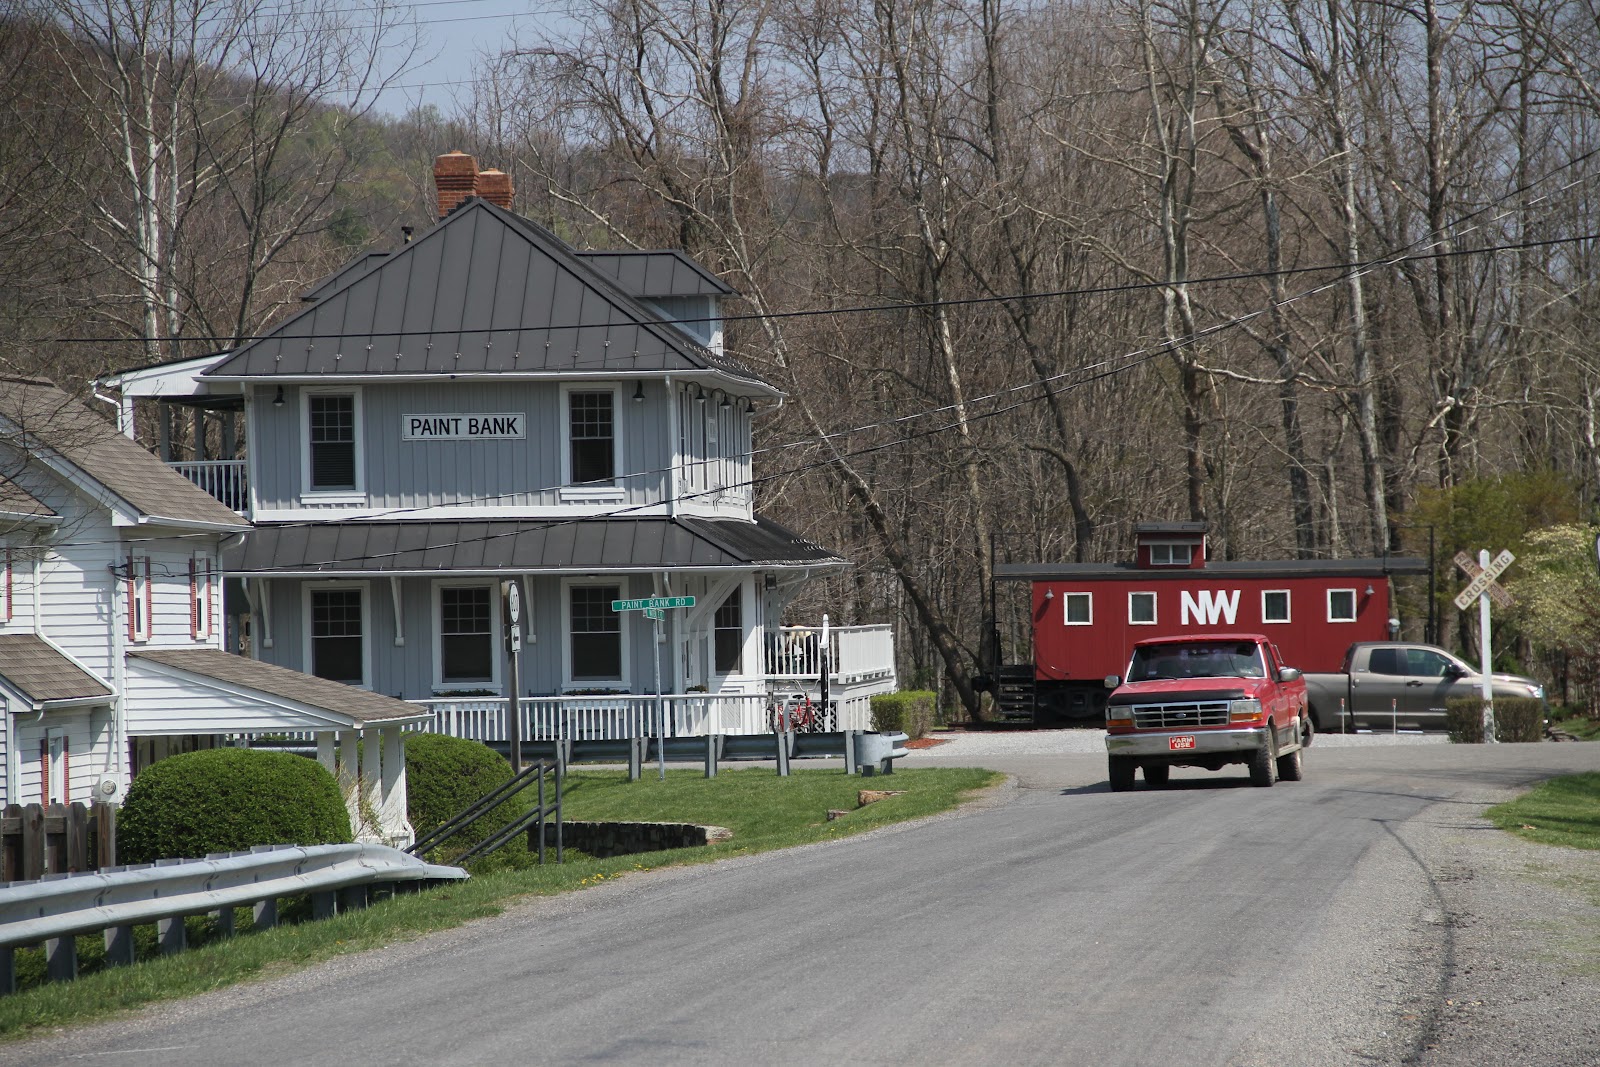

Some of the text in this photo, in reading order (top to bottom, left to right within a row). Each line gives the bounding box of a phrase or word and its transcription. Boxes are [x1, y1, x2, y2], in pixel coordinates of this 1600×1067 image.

[411, 417, 518, 436] PAINT BANK
[1459, 555, 1510, 606] CROSSING
[621, 598, 686, 610] PAINT BANK RD
[1180, 589, 1241, 626] NW
